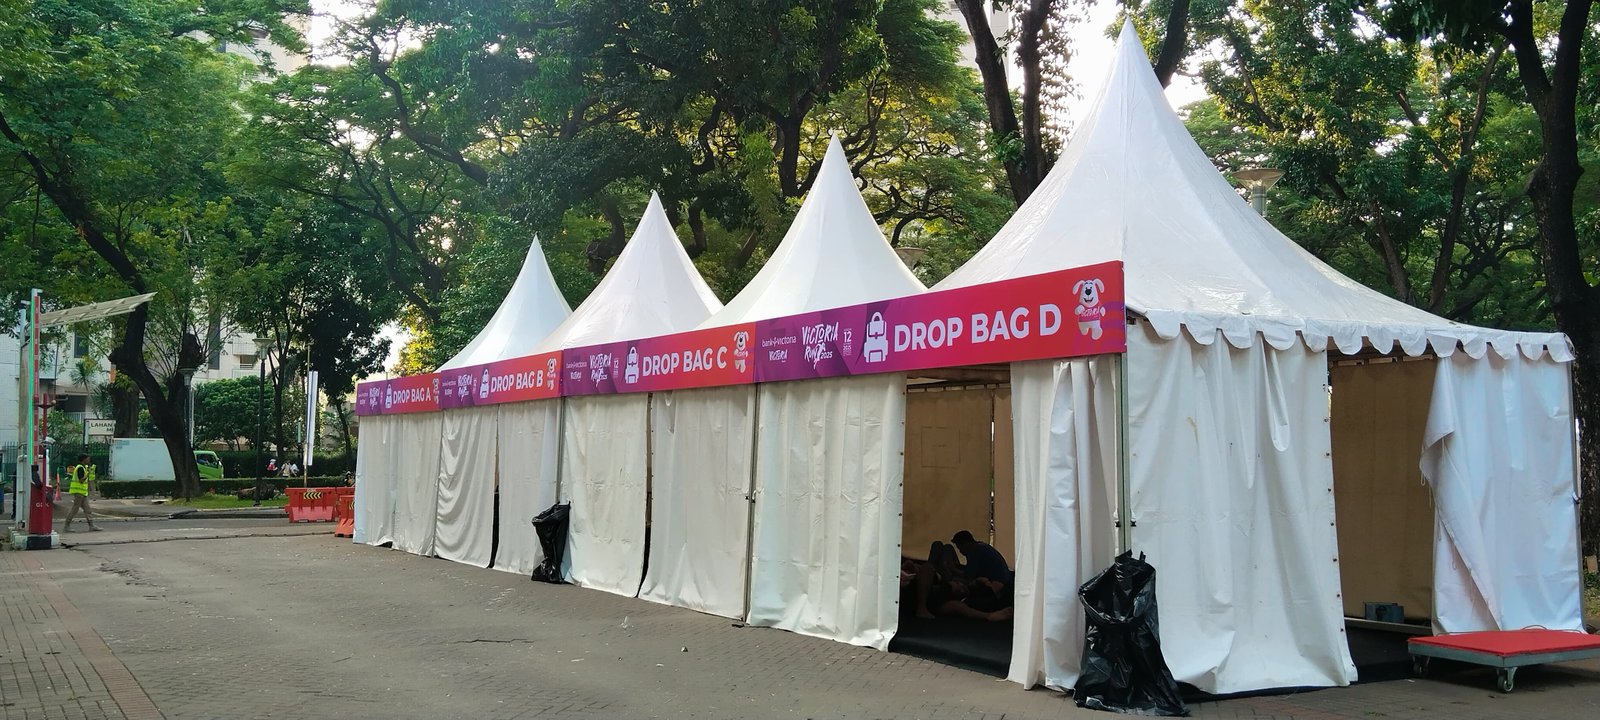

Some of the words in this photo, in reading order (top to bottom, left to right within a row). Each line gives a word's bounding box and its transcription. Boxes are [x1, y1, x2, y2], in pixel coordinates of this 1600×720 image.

[802, 321, 839, 345] VICTORIA
[843, 331, 852, 342] 12
[894, 316, 963, 352] DROP
[971, 307, 1030, 344] BAG
[1039, 303, 1062, 336] D
[642, 352, 679, 376] DROP
[683, 347, 713, 372] BAG
[717, 346, 728, 369] C
[820, 351, 833, 359] 2025
[490, 374, 514, 393] DROP
[516, 371, 535, 390] BAG
[536, 370, 544, 387] B
[393, 390, 411, 404] DROP
[411, 387, 425, 403] BAG
[425, 387, 431, 402] A
